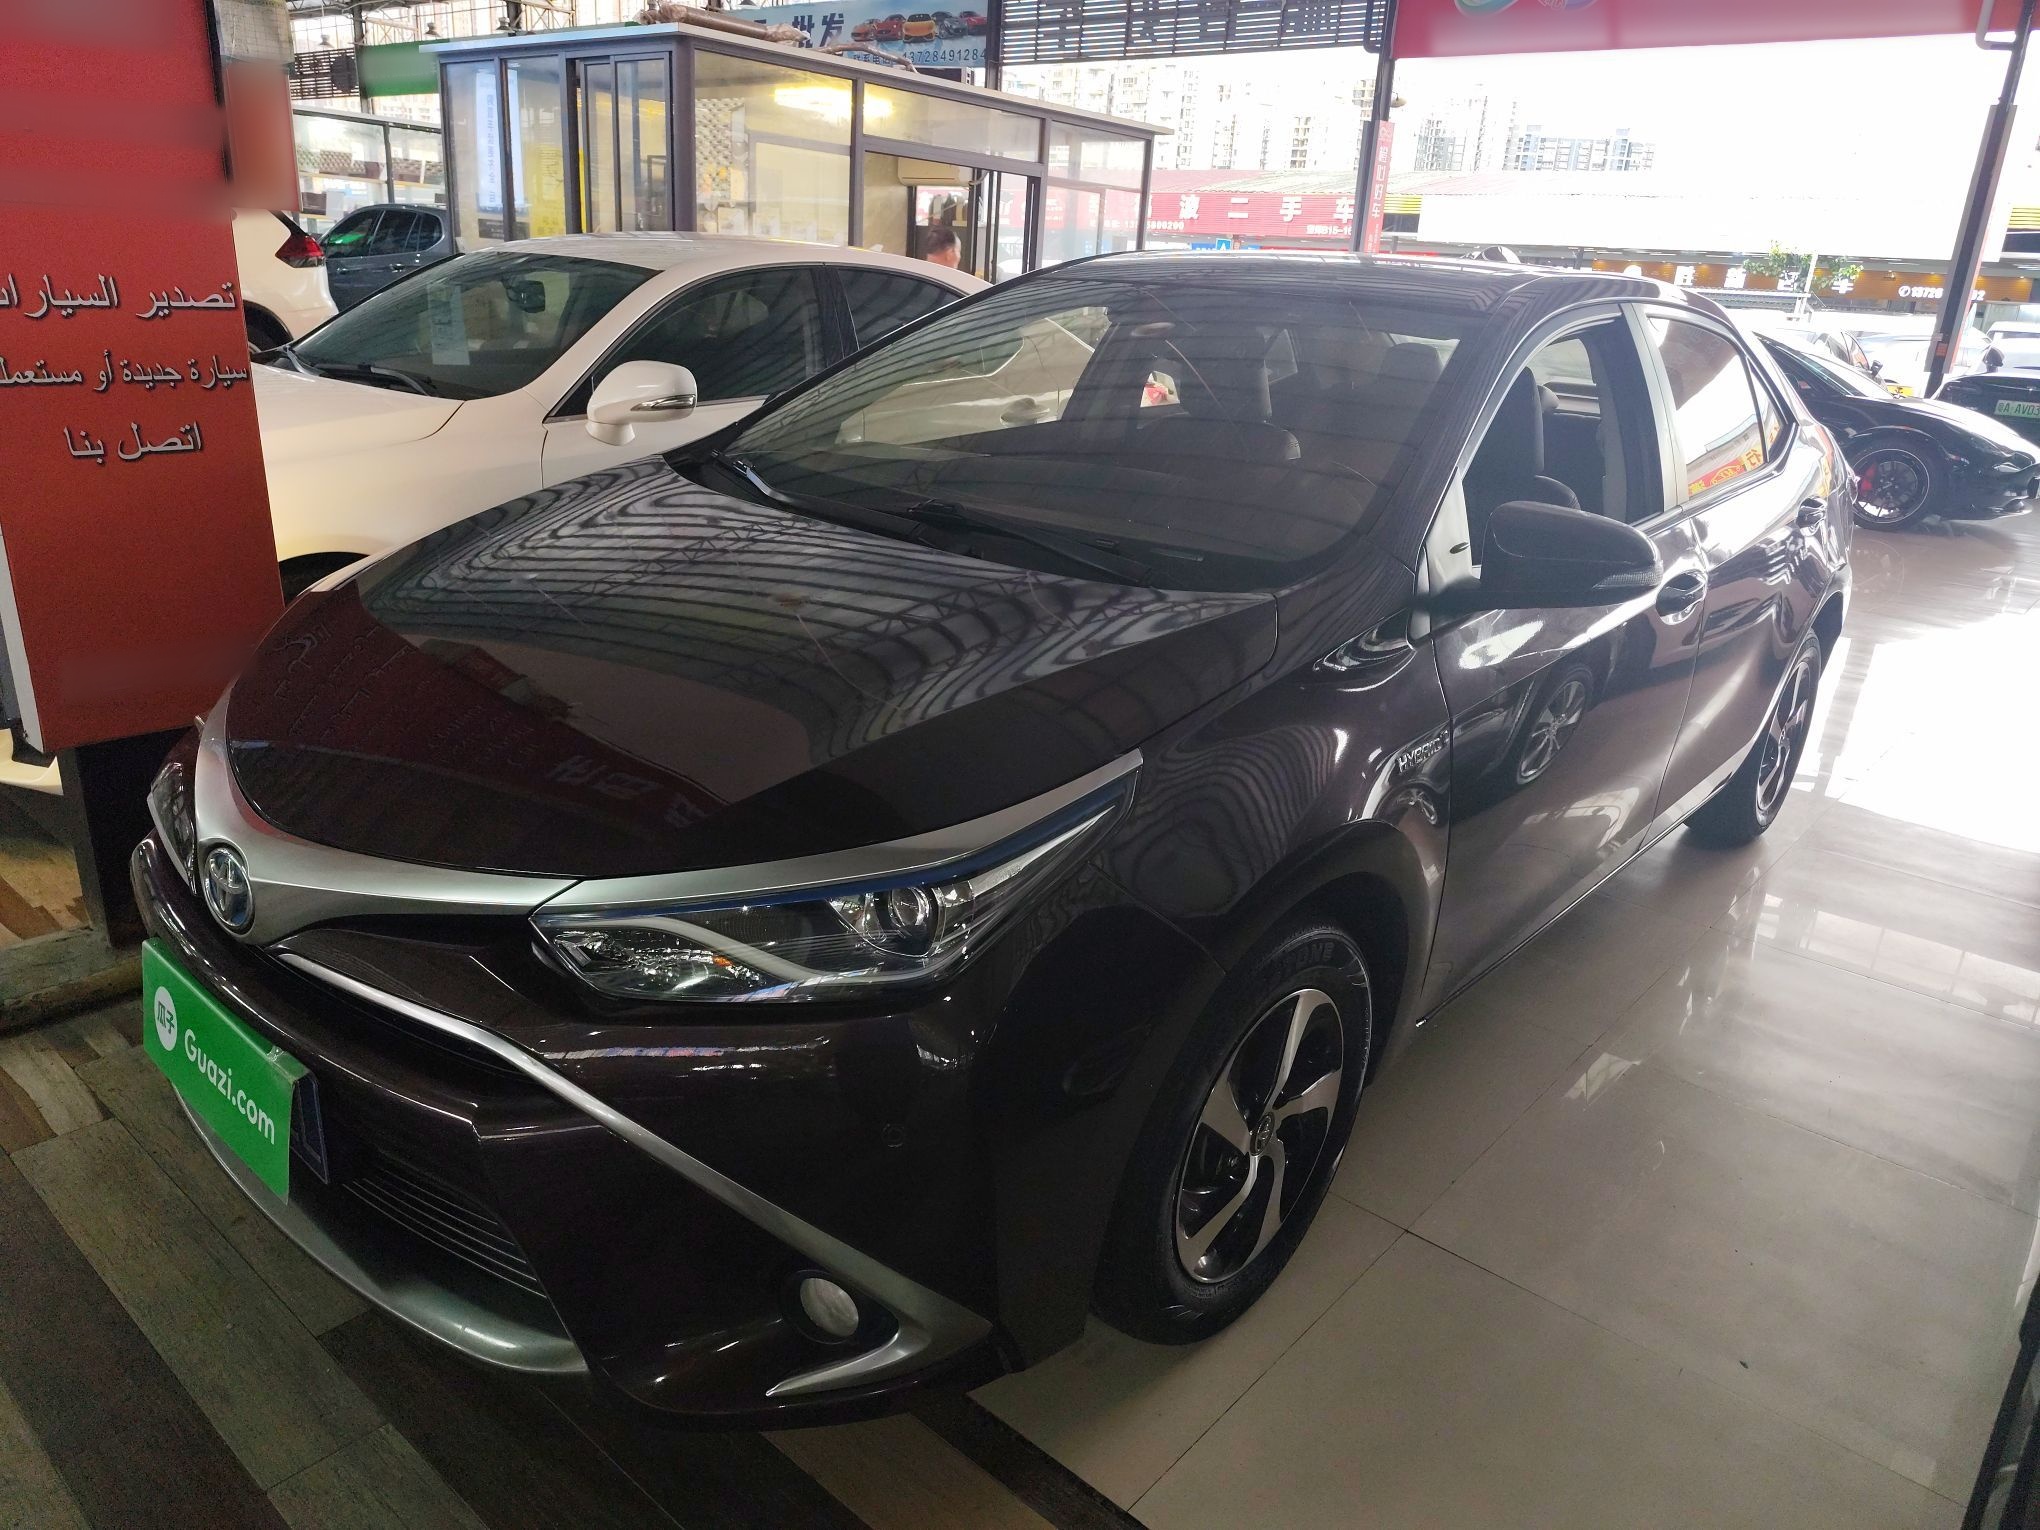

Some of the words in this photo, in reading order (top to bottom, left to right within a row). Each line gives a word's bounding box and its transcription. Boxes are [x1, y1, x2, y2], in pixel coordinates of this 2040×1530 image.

[136, 281, 238, 319] تصدير
[93, 350, 114, 392] أو
[120, 359, 183, 390] جديدة
[187, 355, 249, 390] سيارة
[64, 426, 106, 465] بنا
[117, 421, 203, 461] اتصل
[157, 1001, 176, 1035] 瓜子
[184, 1028, 276, 1146] Guazi.com
